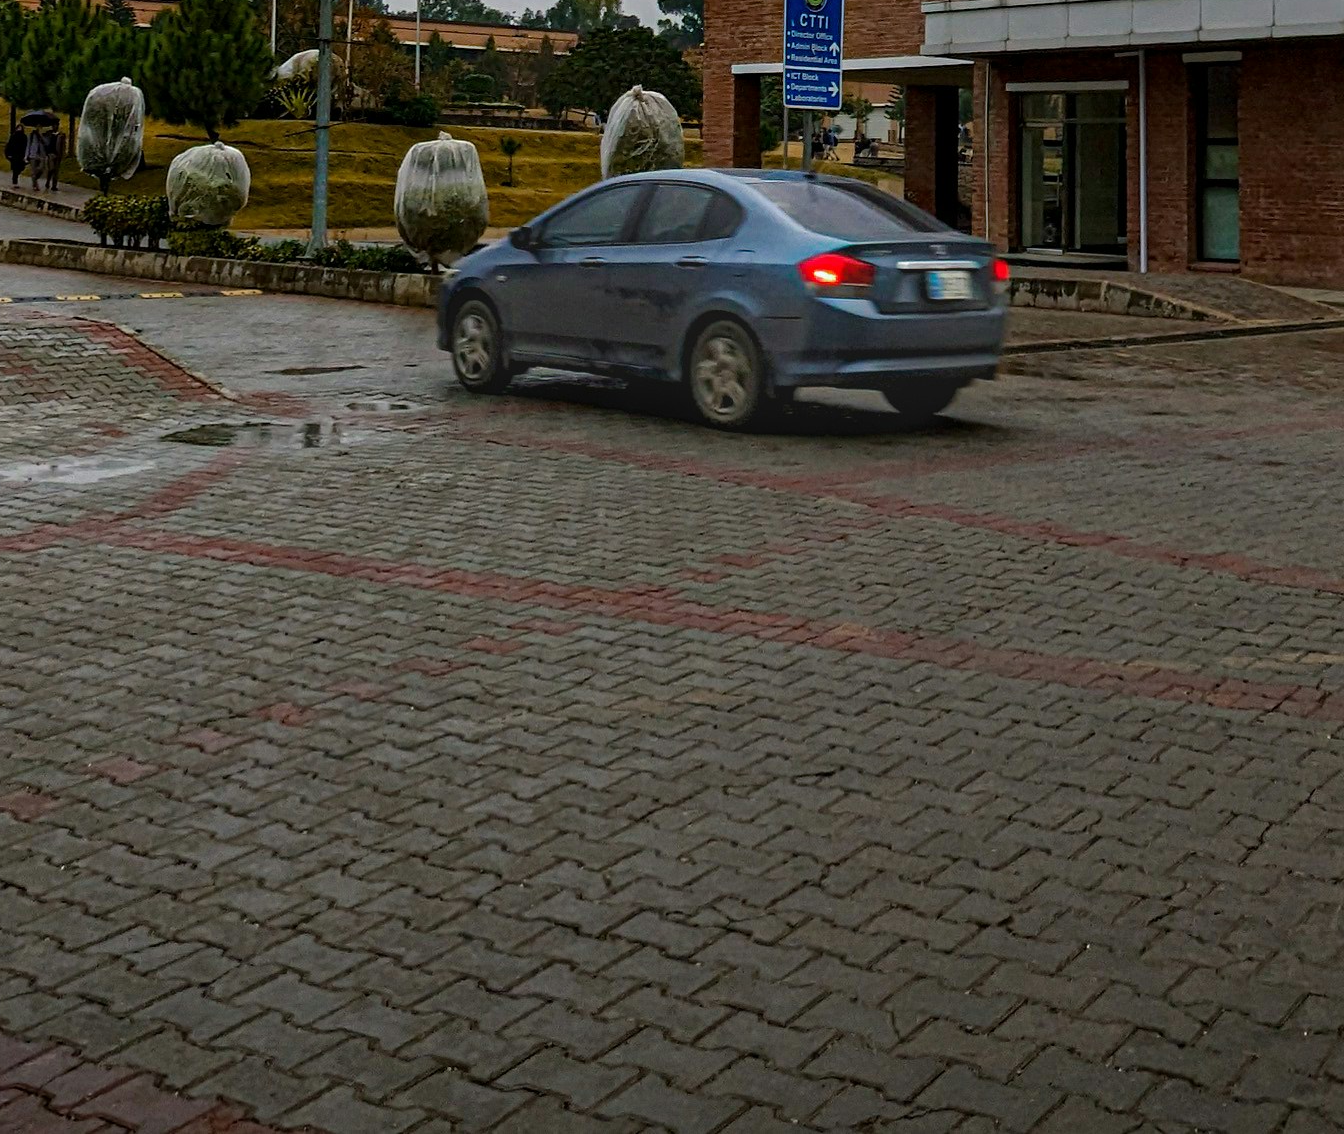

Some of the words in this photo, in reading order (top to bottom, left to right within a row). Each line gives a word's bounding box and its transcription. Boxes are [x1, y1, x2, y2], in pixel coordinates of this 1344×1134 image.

[799, 13, 829, 29] CTTI
[791, 30, 815, 39] Director
[816, 32, 833, 40] Office
[791, 42, 811, 50] Admin
[811, 43, 828, 52] Block
[791, 54, 823, 63] Residential
[824, 57, 838, 65] Area
[791, 72, 801, 80] ICT
[802, 73, 819, 81] Block
[791, 82, 827, 93] Departments
[791, 94, 827, 103] Laboratories
